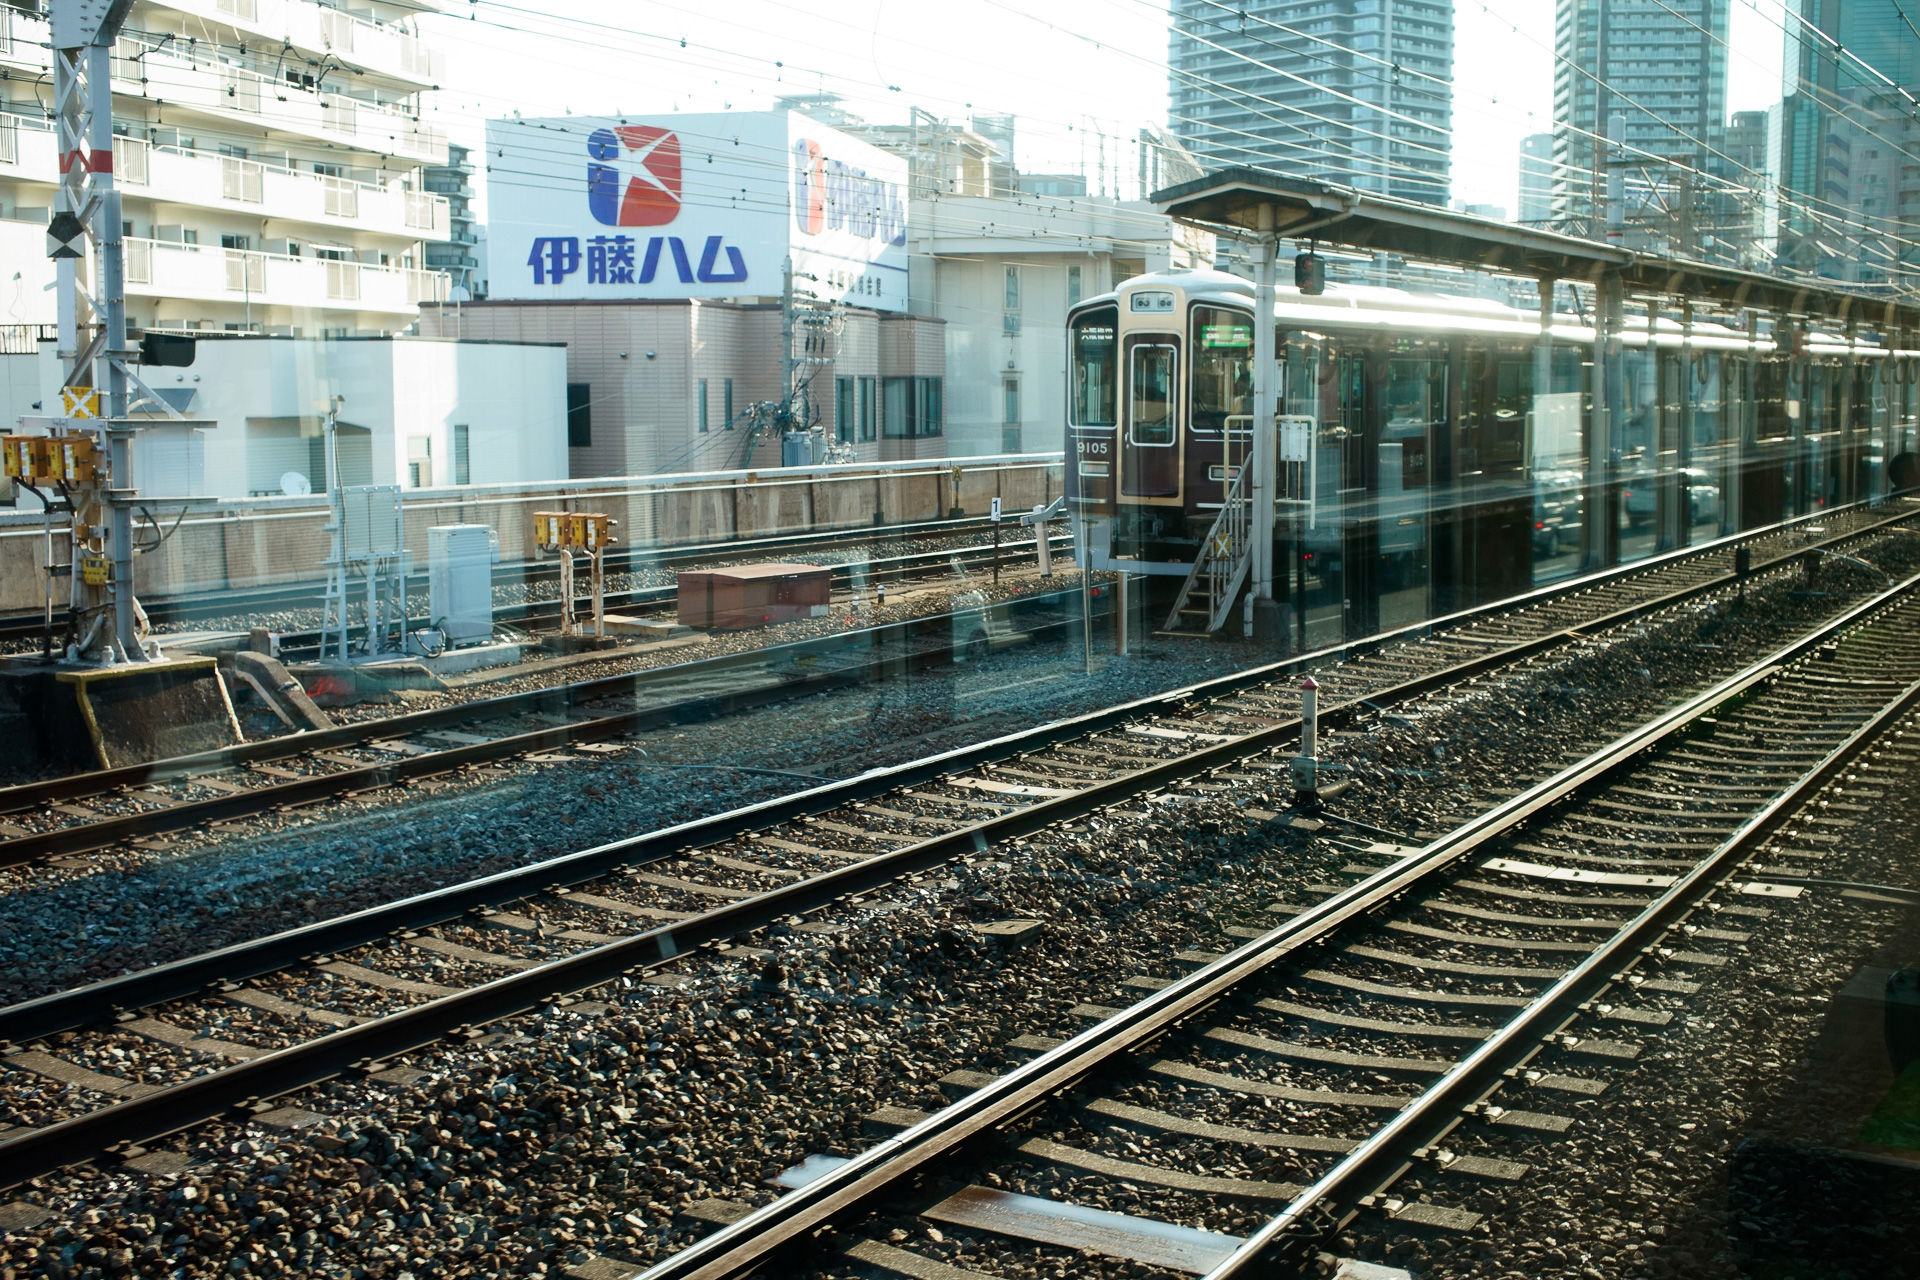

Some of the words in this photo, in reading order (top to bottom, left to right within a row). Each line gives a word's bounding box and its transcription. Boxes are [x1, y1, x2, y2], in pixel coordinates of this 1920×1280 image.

[527, 235, 748, 285] 伊藤ハム
[1077, 441, 1108, 454] 9105
[993, 500, 998, 512] 1
